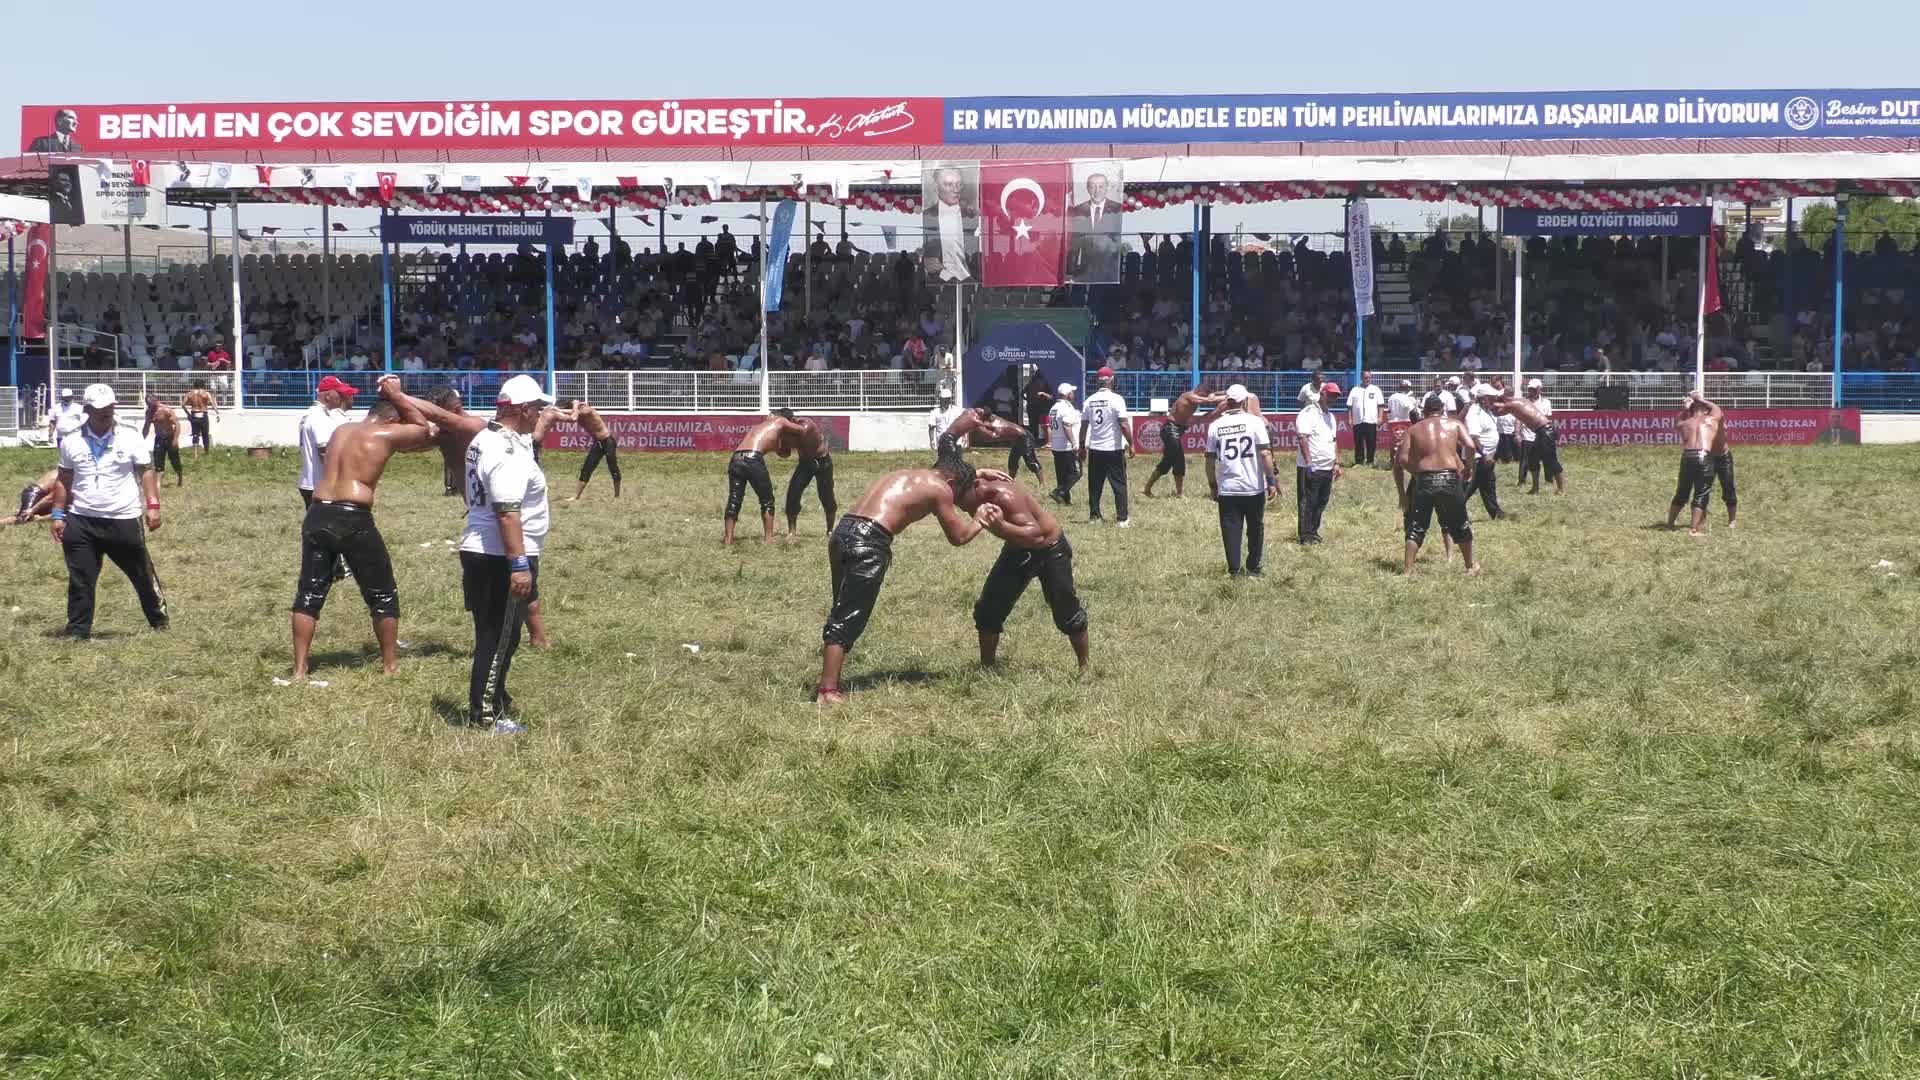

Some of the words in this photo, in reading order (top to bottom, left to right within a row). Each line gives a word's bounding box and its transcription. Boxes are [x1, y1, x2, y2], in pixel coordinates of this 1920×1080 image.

[953, 110, 978, 130] ER
[984, 108, 1117, 129] MEYDANINDA
[1122, 103, 1230, 128] MÜCADELE
[1235, 107, 1287, 127] EDEN
[1292, 102, 1336, 127] TÜM
[1342, 100, 1538, 127] PEHLİVANLARIMIZA
[1544, 103, 1659, 128] BAŞARILAR
[1665, 97, 1779, 125] DİLİYORUM
[1826, 100, 1878, 117] Besim
[99, 105, 206, 139] BENİM
[214, 112, 260, 137] EN
[267, 111, 344, 142] ÇOK
[351, 102, 521, 137] SEVDİĞİM
[528, 109, 624, 136] SPOR
[631, 100, 815, 139] GÜREŞTİR.
[1537, 215, 1576, 227] ERDEM
[1579, 211, 1624, 227] ÖZYİĞİT
[1627, 211, 1678, 227] TRİBÜNÜ
[409, 221, 446, 236] YÖRÜK
[448, 223, 494, 236] MEHMET
[496, 221, 543, 236] TRİBÜNÜ
[1095, 409, 1103, 425] 3
[1570, 416, 1675, 430] PEHLİVANLARI
[1726, 419, 1777, 428] AHDETTİN
[1780, 417, 1817, 428] ÖZKAN
[607, 419, 712, 433] LİVANLARIMIZA
[718, 425, 752, 433] VAHDE
[1224, 436, 1254, 461] 52
